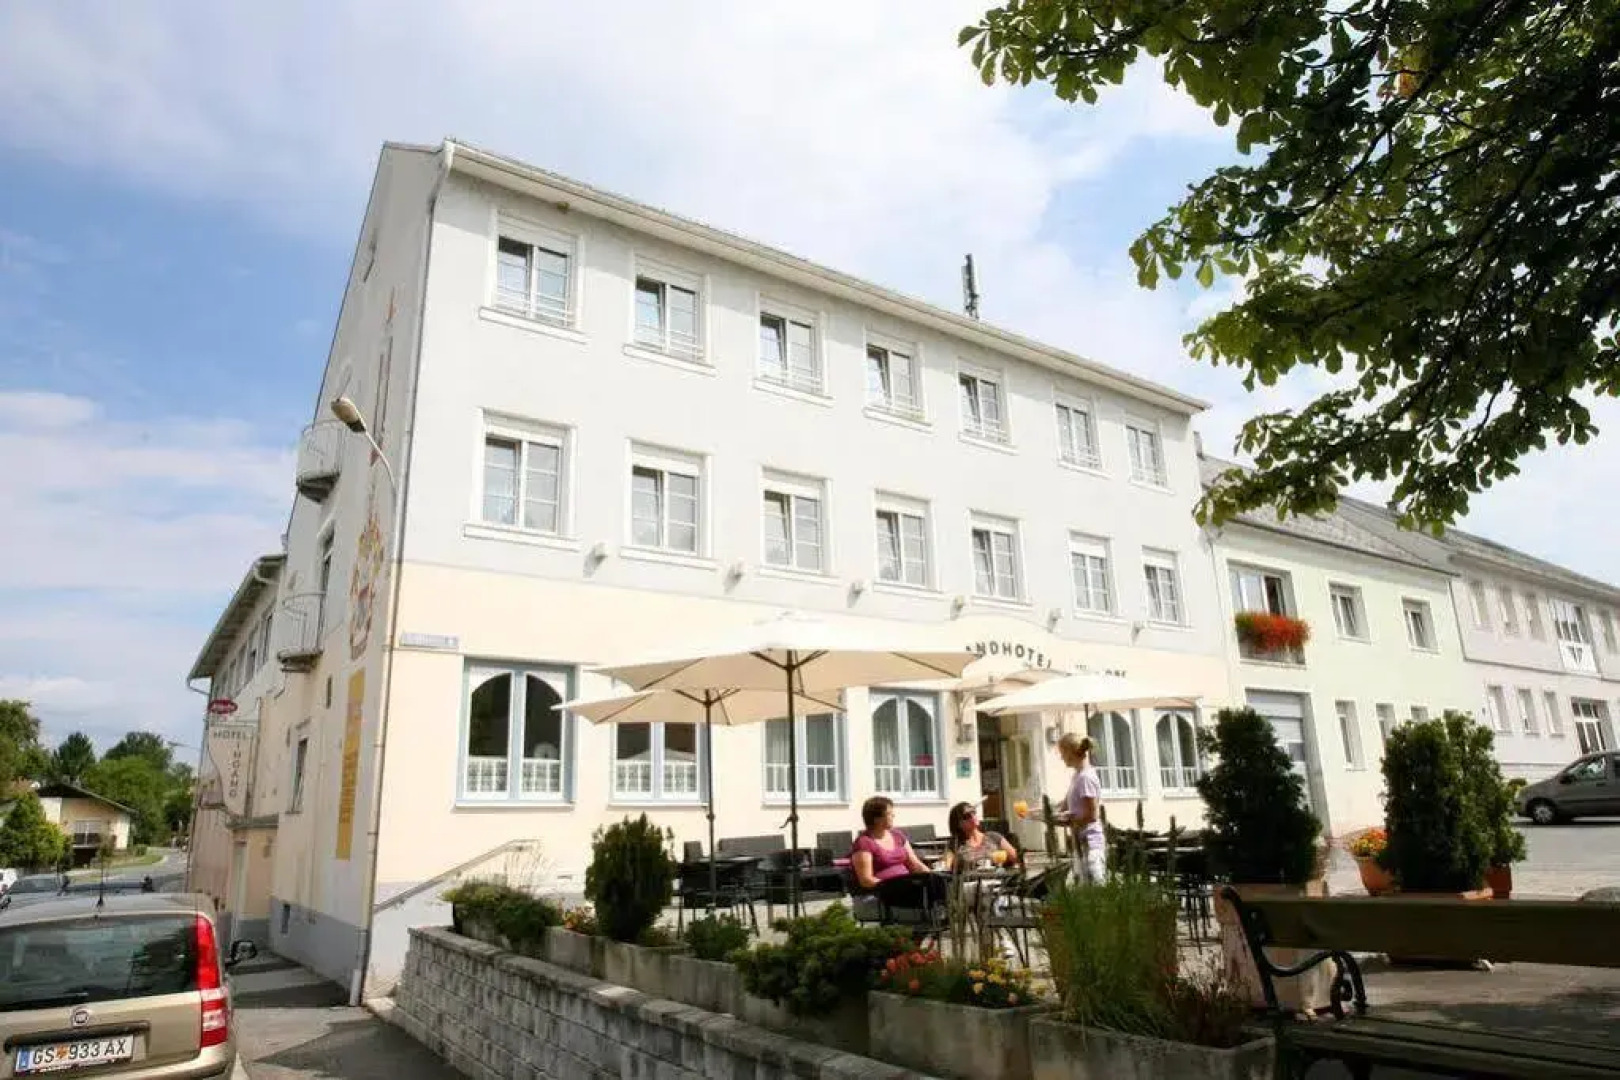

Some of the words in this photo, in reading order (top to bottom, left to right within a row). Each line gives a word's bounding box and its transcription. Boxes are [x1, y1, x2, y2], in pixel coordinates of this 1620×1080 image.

[213, 730, 247, 741] HOTEL
[33, 1047, 55, 1065] GS
[68, 1042, 100, 1060] 933
[105, 1039, 126, 1056] AX
